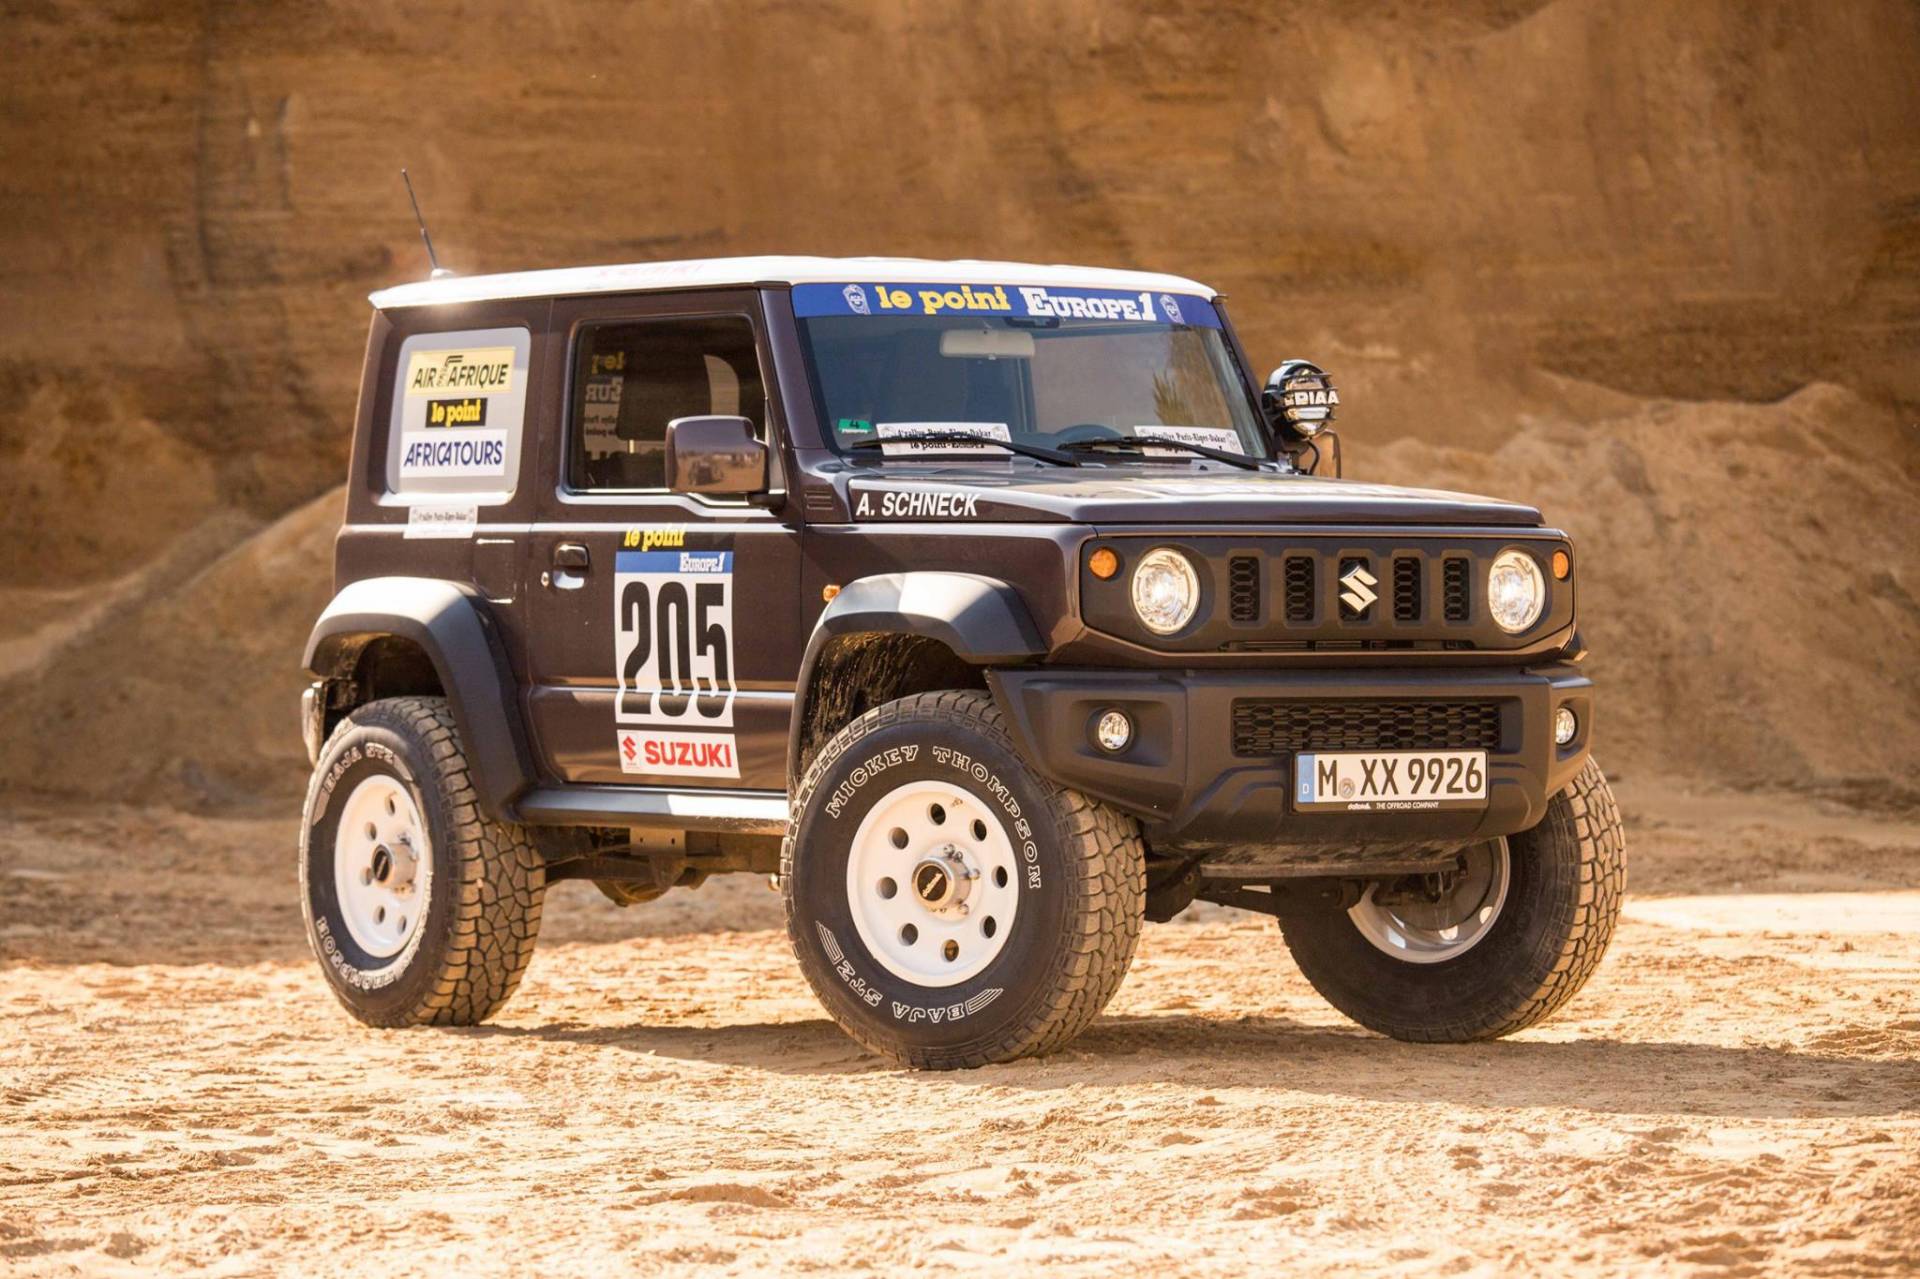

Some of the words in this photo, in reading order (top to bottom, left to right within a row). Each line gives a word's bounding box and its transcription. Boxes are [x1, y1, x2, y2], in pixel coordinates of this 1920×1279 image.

[875, 285, 912, 309] le
[919, 285, 1012, 315] point
[1019, 287, 1157, 321] EUROPE1
[413, 368, 437, 388] AIR
[448, 364, 509, 388] AFRIQUE
[431, 402, 445, 422] le
[445, 398, 481, 427] point
[404, 440, 503, 467] AFRICATOURS
[856, 492, 875, 516] A.
[881, 492, 980, 517] SCHNECK
[624, 527, 641, 547] le
[642, 524, 687, 552] point
[621, 581, 729, 719] 205
[644, 740, 732, 768] SUZUKI
[1302, 784, 1309, 794] D
[1318, 760, 1337, 796] M
[1360, 758, 1399, 796] XX
[1407, 757, 1483, 795] 9926
[826, 745, 919, 819] MICKEY
[932, 745, 1042, 889] THOMPSON
[836, 961, 883, 1007] STZ
[892, 1001, 965, 1023] BAJA
